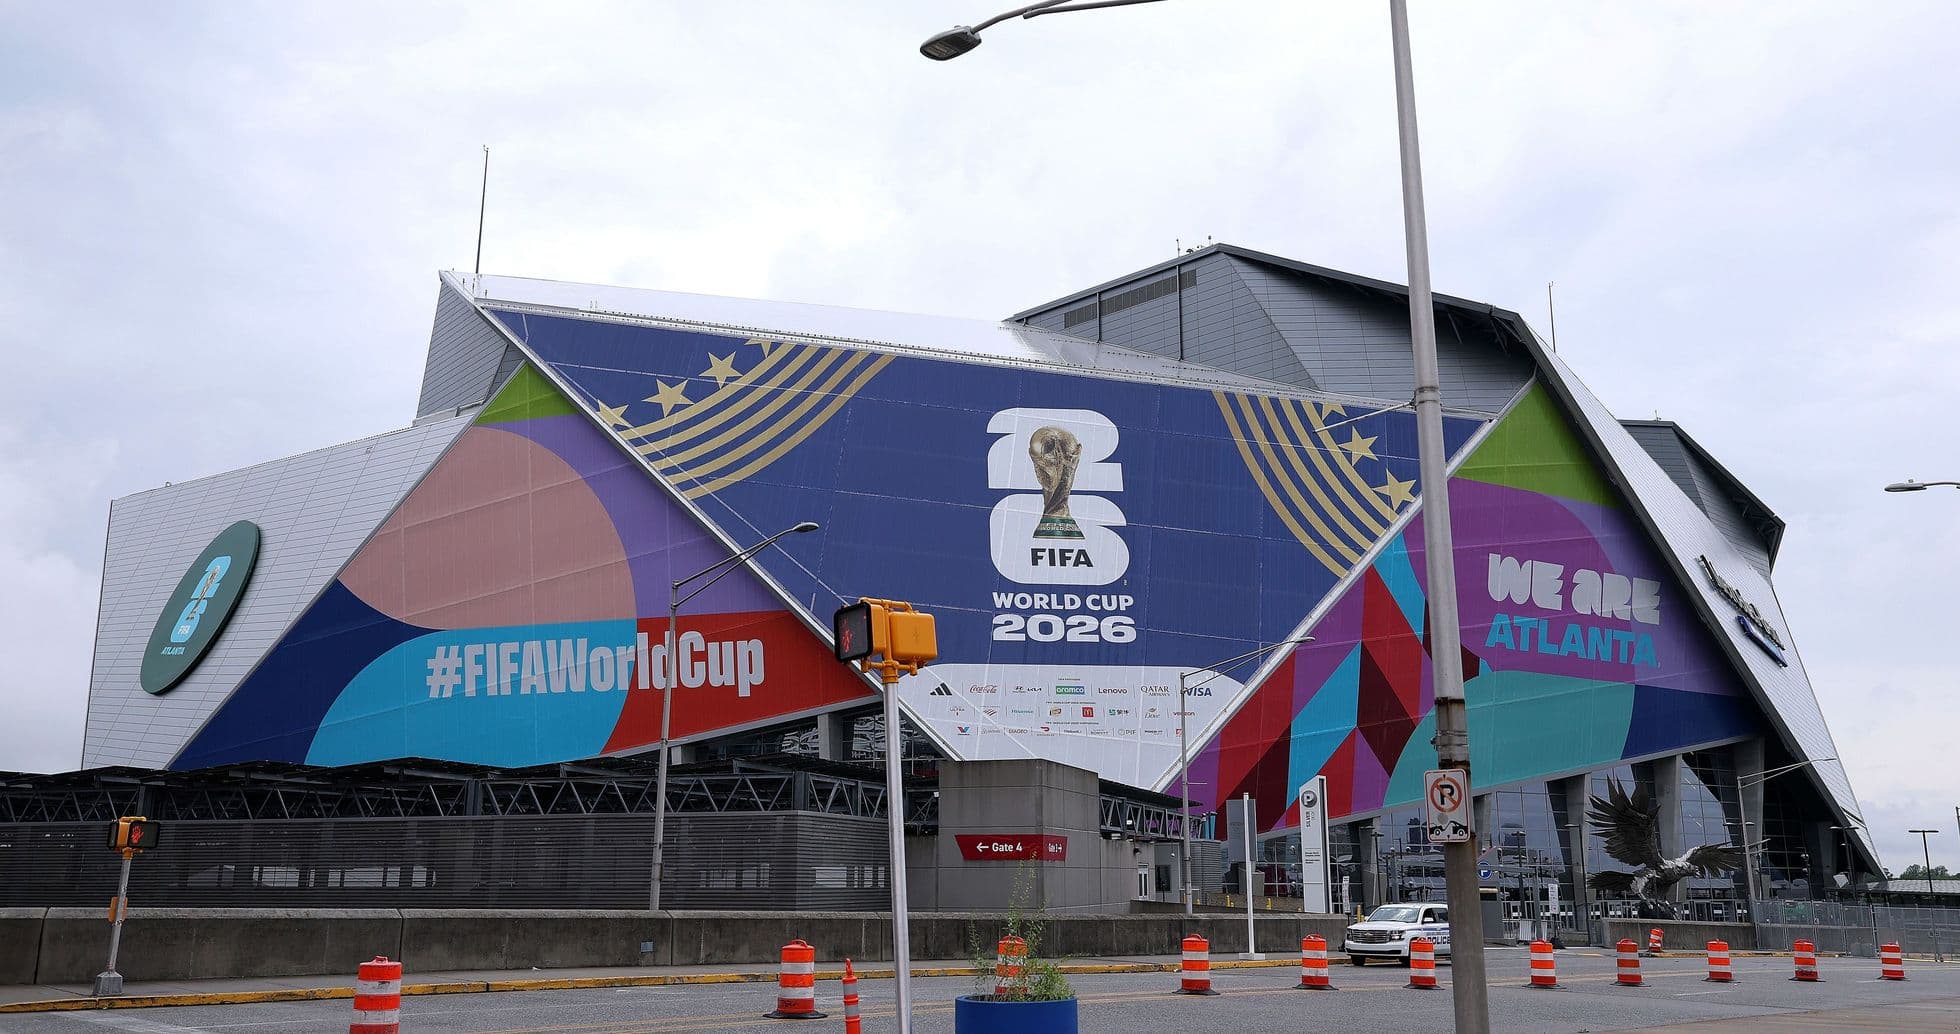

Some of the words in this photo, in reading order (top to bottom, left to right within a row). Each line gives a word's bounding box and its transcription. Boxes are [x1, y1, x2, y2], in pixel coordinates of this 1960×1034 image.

[1030, 547, 1094, 568] FIFA
[1487, 553, 1564, 611] WE
[992, 591, 1082, 610] WORLD
[1085, 594, 1134, 611] CUP
[992, 613, 1137, 643] 2026
[1485, 613, 1659, 669] ATLANTA
[160, 646, 186, 655] ATLANTA
[426, 630, 766, 698] #FIFAWorldCup
[1056, 686, 1085, 694] aramco
[1140, 685, 1169, 694] QATAR
[1184, 686, 1213, 697] VISA
[991, 843, 1014, 852] Gate
[1016, 842, 1023, 852] 4
[1427, 935, 1451, 945] POLICE
